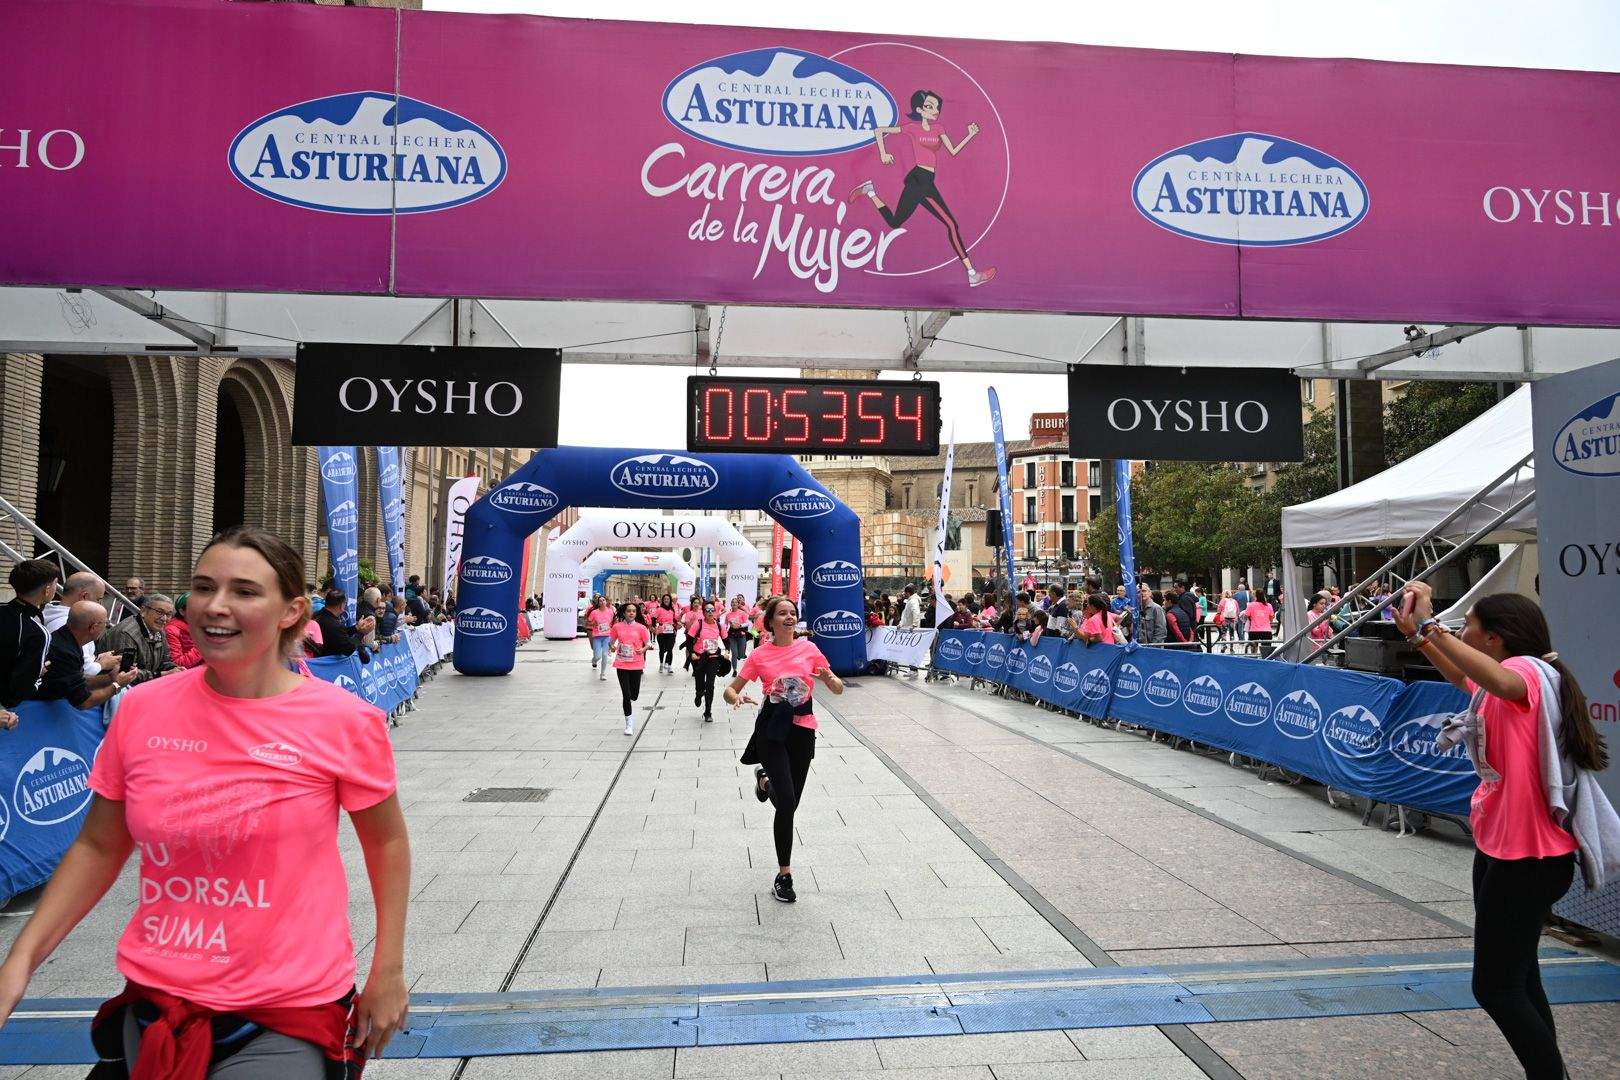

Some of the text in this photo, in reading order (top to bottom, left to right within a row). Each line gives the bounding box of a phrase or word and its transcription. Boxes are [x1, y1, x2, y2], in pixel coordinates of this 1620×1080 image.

[718, 82, 873, 100] CENTRAL LECHERA
[681, 83, 878, 131] ASTURIANA
[295, 132, 478, 150] CENTRAL LECHERA
[250, 133, 486, 186] ASTURIANA
[641, 142, 836, 205] Carrera
[1188, 169, 1343, 186] CENTRAL LECHERA
[1151, 171, 1352, 219] ASTURIANA
[688, 201, 907, 293] de la Mujer
[339, 376, 523, 416] OYSHO
[1107, 398, 1269, 433] OYSHO
[1563, 432, 1620, 462] ASTU
[619, 466, 710, 487] ASTURIANA
[493, 492, 553, 506] ASTURIANA
[775, 500, 831, 511] ASTURIANA
[613, 522, 696, 538] OYSHO
[1227, 694, 1267, 718] ASTURIANA
[147, 736, 208, 753] OYSHO
[23, 773, 89, 815] ASTURIANA
[141, 876, 271, 908] DORSAL
[143, 915, 228, 952] SUMA
